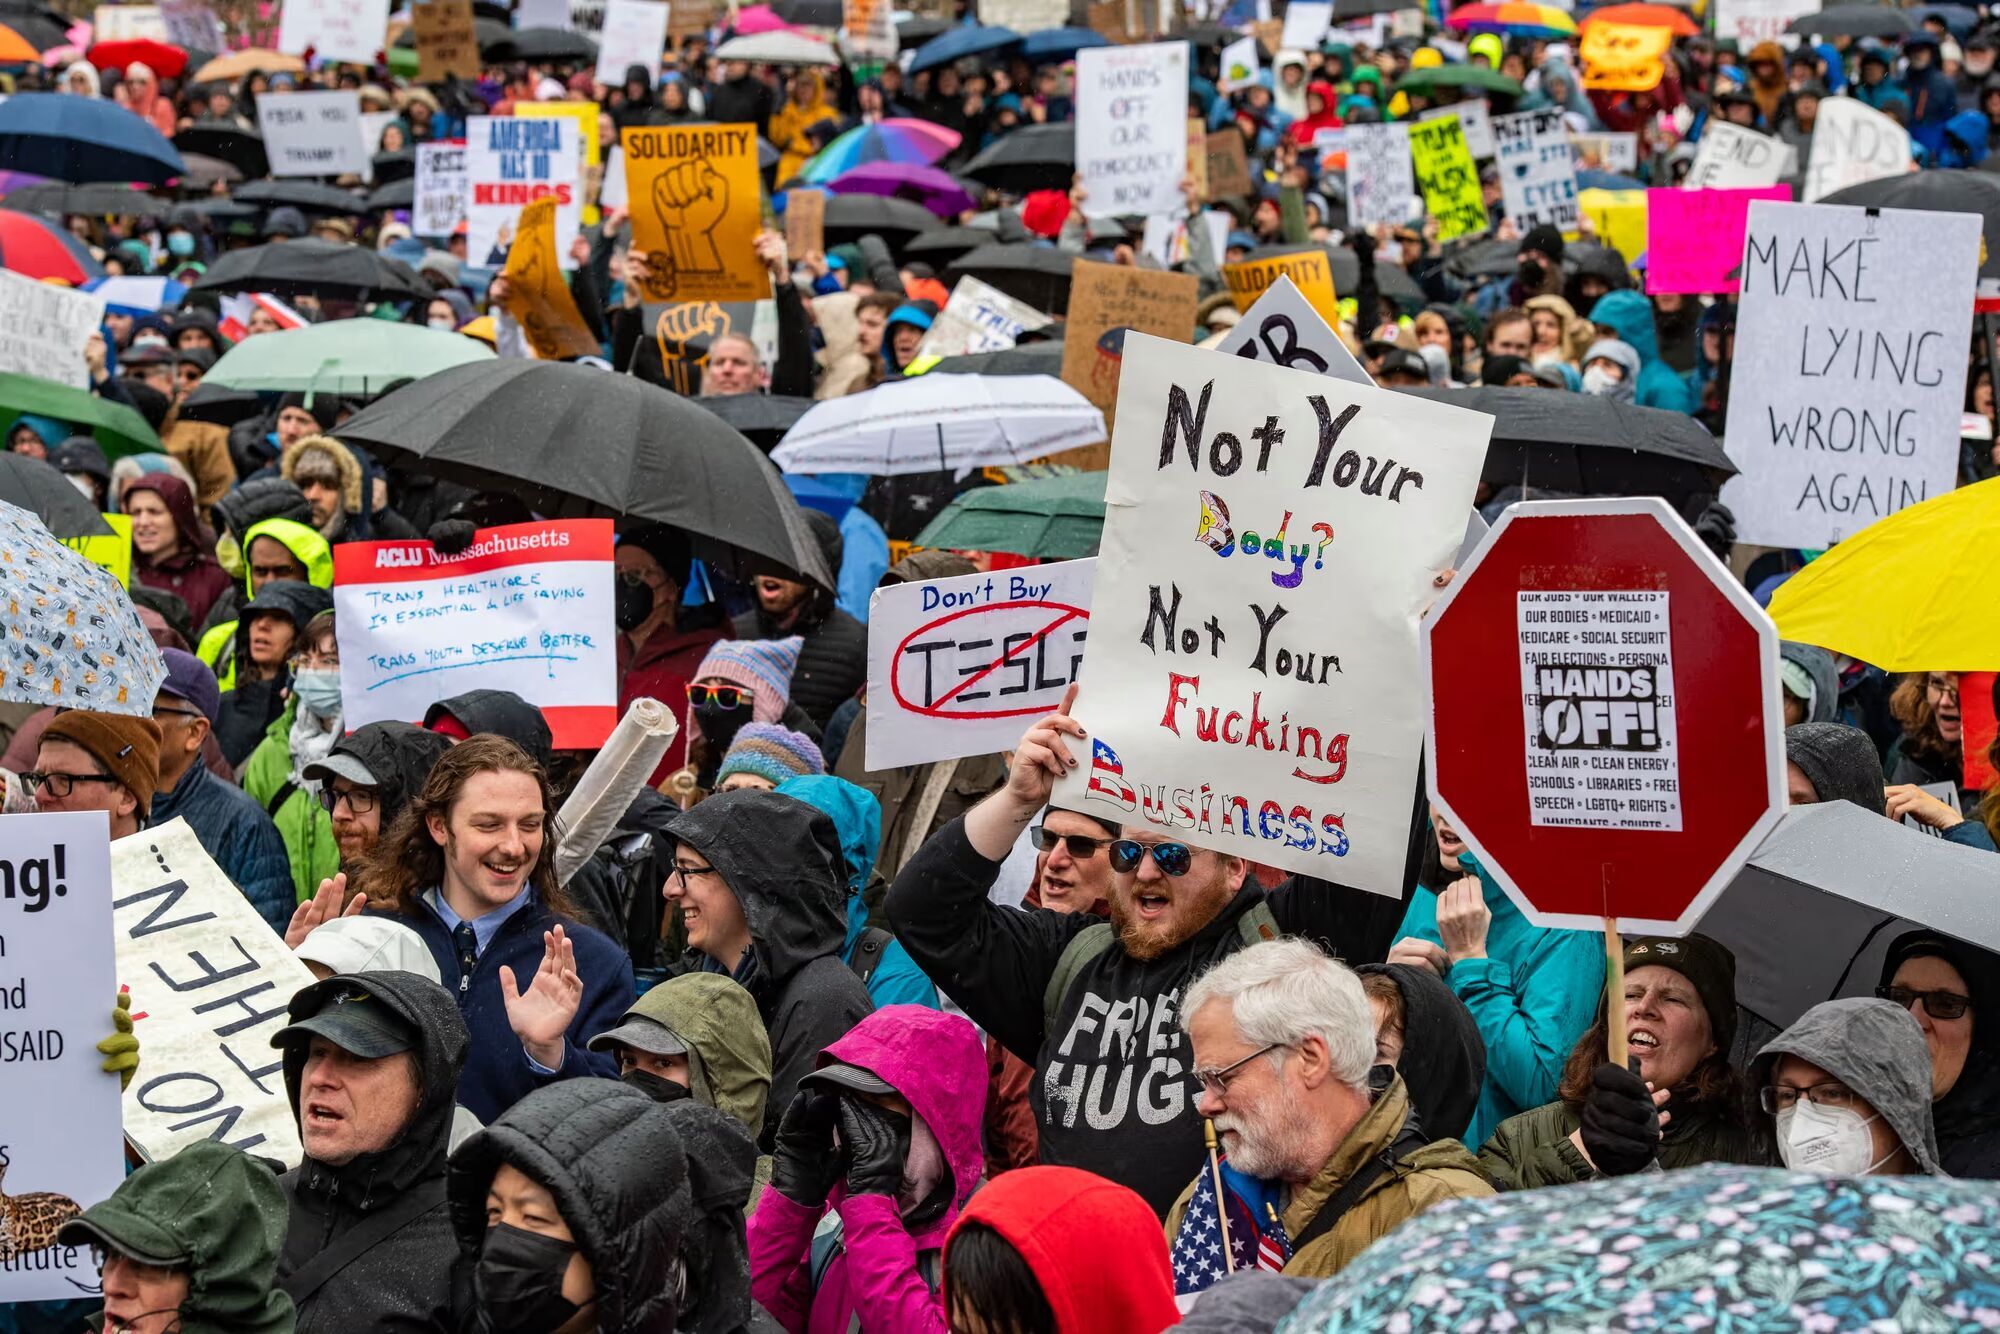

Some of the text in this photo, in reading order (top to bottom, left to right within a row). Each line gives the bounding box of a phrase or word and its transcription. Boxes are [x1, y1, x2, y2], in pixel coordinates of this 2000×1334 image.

[1109, 96, 1152, 119] OFF
[490, 120, 560, 150] AMERICA
[628, 131, 749, 160] SOLIDARITY
[474, 184, 571, 205] KINGS
[1113, 185, 1153, 204] NOW
[1745, 235, 1880, 302] MAKE
[1801, 325, 1943, 387] LYING
[1157, 378, 1424, 504] Not Your
[1768, 405, 1916, 457] WRONG
[1797, 473, 1926, 516] AGAIN
[1195, 490, 1335, 589] Body?
[374, 547, 423, 568] ACLU
[366, 588, 424, 605] TRANS
[921, 576, 1052, 612] Don't Buy
[395, 603, 477, 625] ESSENTIAL
[1526, 610, 1651, 624] OUR BODIES MEDICAID
[1140, 580, 1344, 686] Not Your
[1582, 632, 1618, 644] SOCIAL
[367, 630, 596, 673] TRANS YOUTH DESERVE BETTER
[1525, 652, 1548, 665] FAIR
[1552, 653, 1607, 666] ELECTIONS
[1540, 669, 1653, 698] HANDS
[1160, 671, 1350, 785] Fucking
[1542, 700, 1657, 746] OFF!
[1562, 757, 1579, 769] AIR
[1592, 757, 1624, 770] CLEAN
[1628, 758, 1669, 771] ENERGY
[1085, 737, 1350, 858] Business
[1587, 778, 1642, 791] LIBRARIES
[1535, 797, 1667, 812] SPEECH LGBTQ+ RIGHTS
